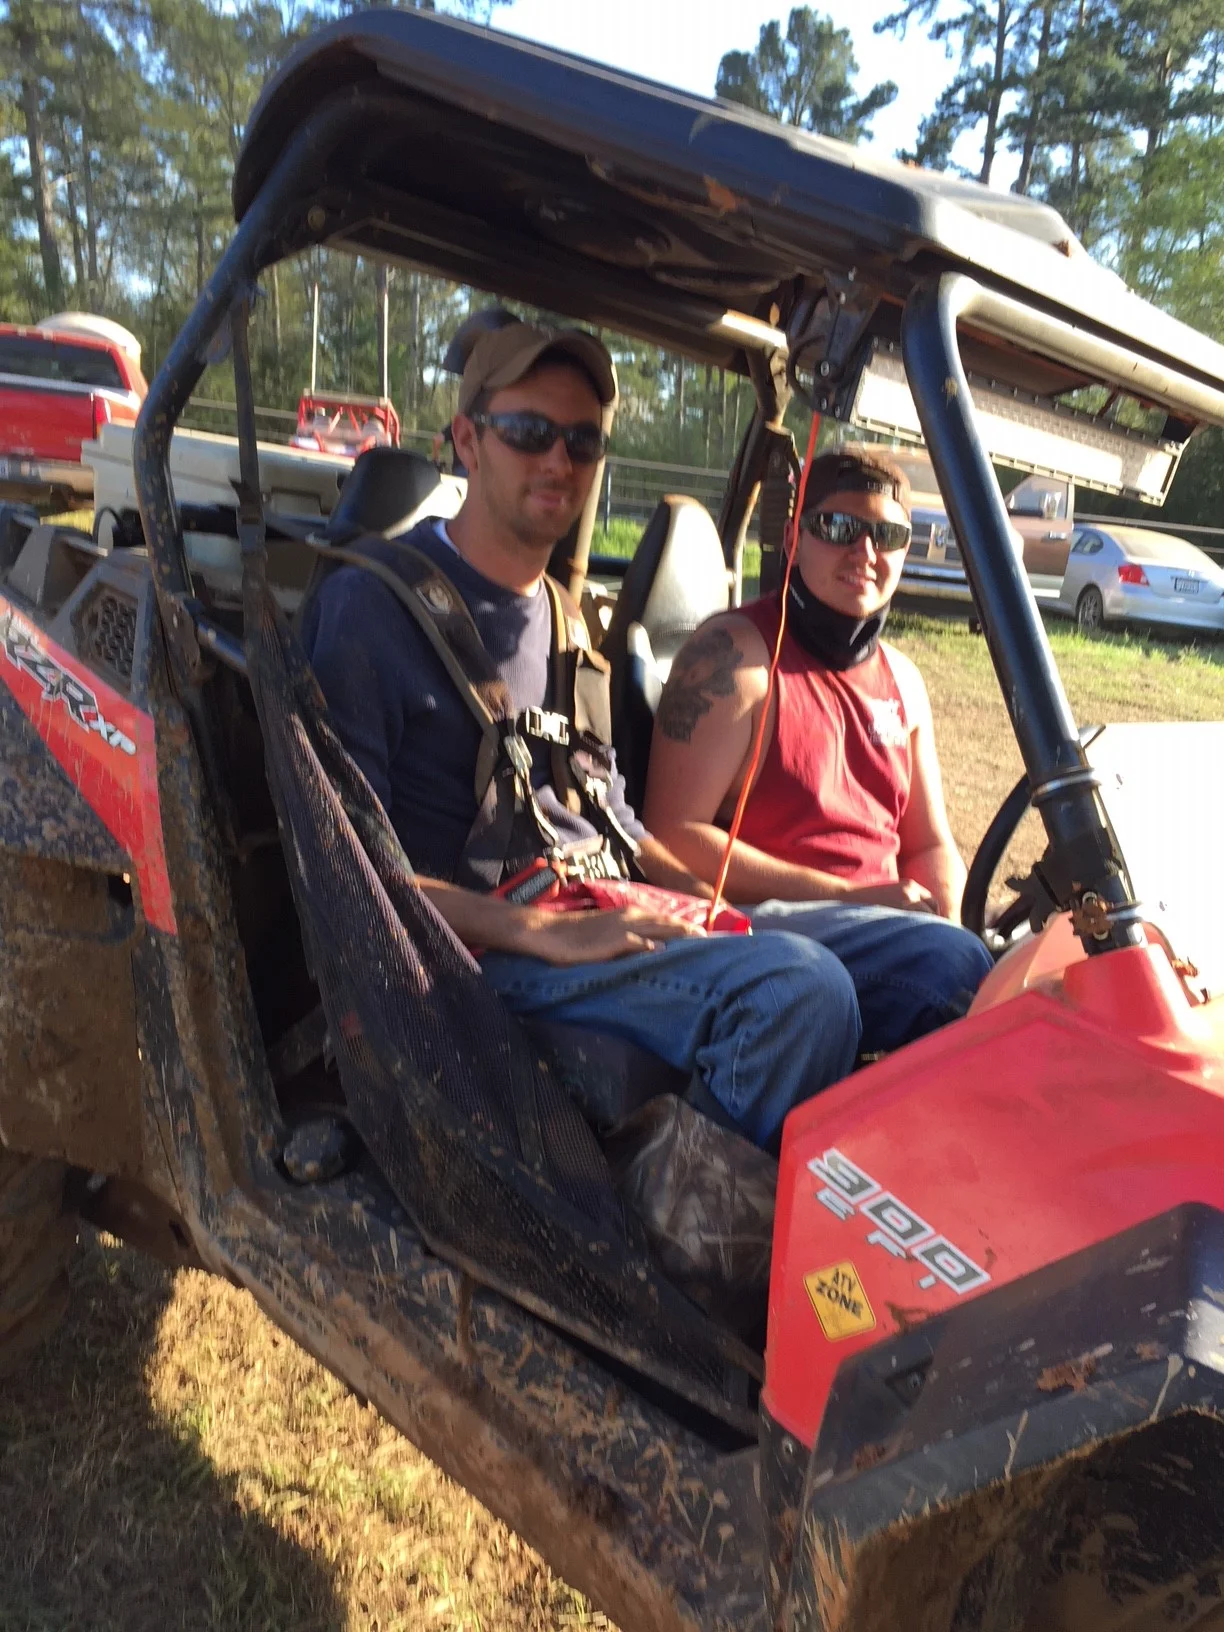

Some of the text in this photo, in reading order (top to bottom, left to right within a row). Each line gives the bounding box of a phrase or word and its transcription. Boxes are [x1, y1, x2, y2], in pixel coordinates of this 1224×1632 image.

[89, 713, 136, 755] XP
[806, 1147, 992, 1294] 900
[815, 1187, 936, 1289] EFI
[815, 1277, 864, 1320] ZONE
